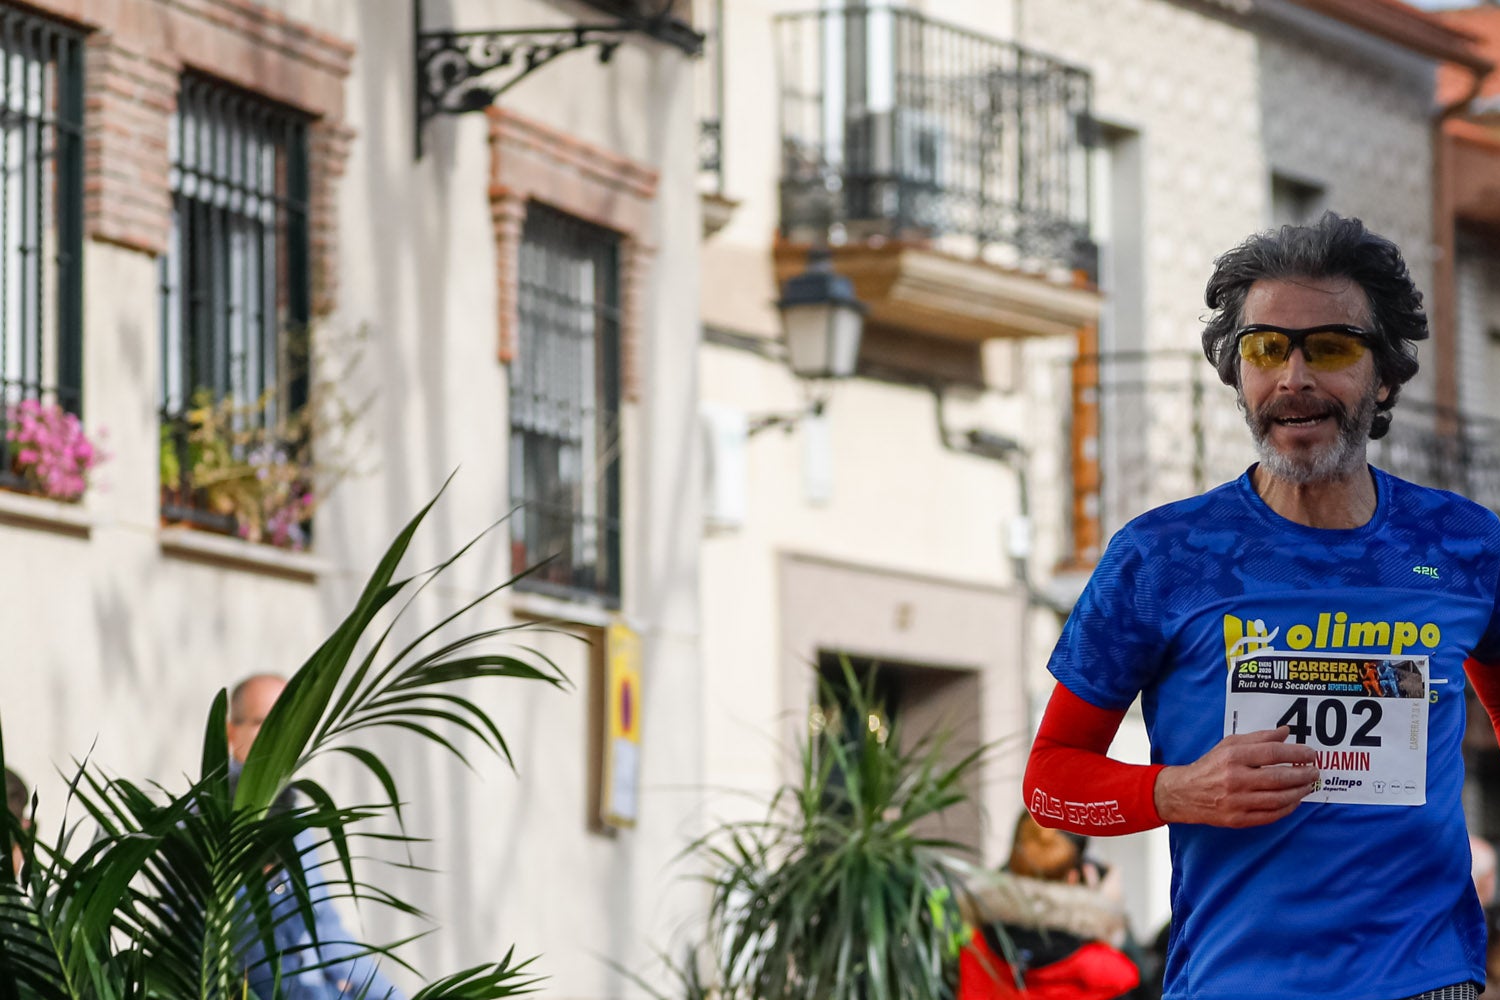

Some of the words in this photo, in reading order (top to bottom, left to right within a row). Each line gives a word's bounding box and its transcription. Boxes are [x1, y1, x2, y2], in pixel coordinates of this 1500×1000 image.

[1286, 611, 1441, 656] olimpo
[1239, 660, 1258, 673] 26
[1289, 661, 1358, 672] CARRERA
[1290, 672, 1358, 681] POPULAR
[1238, 680, 1257, 688] Ruta
[1259, 680, 1269, 689] de
[1270, 681, 1283, 690] los
[1285, 681, 1327, 691] Secaderos
[1277, 697, 1383, 747] 402
[1292, 751, 1370, 771] NJAMIN
[1324, 777, 1363, 788] olimpo
